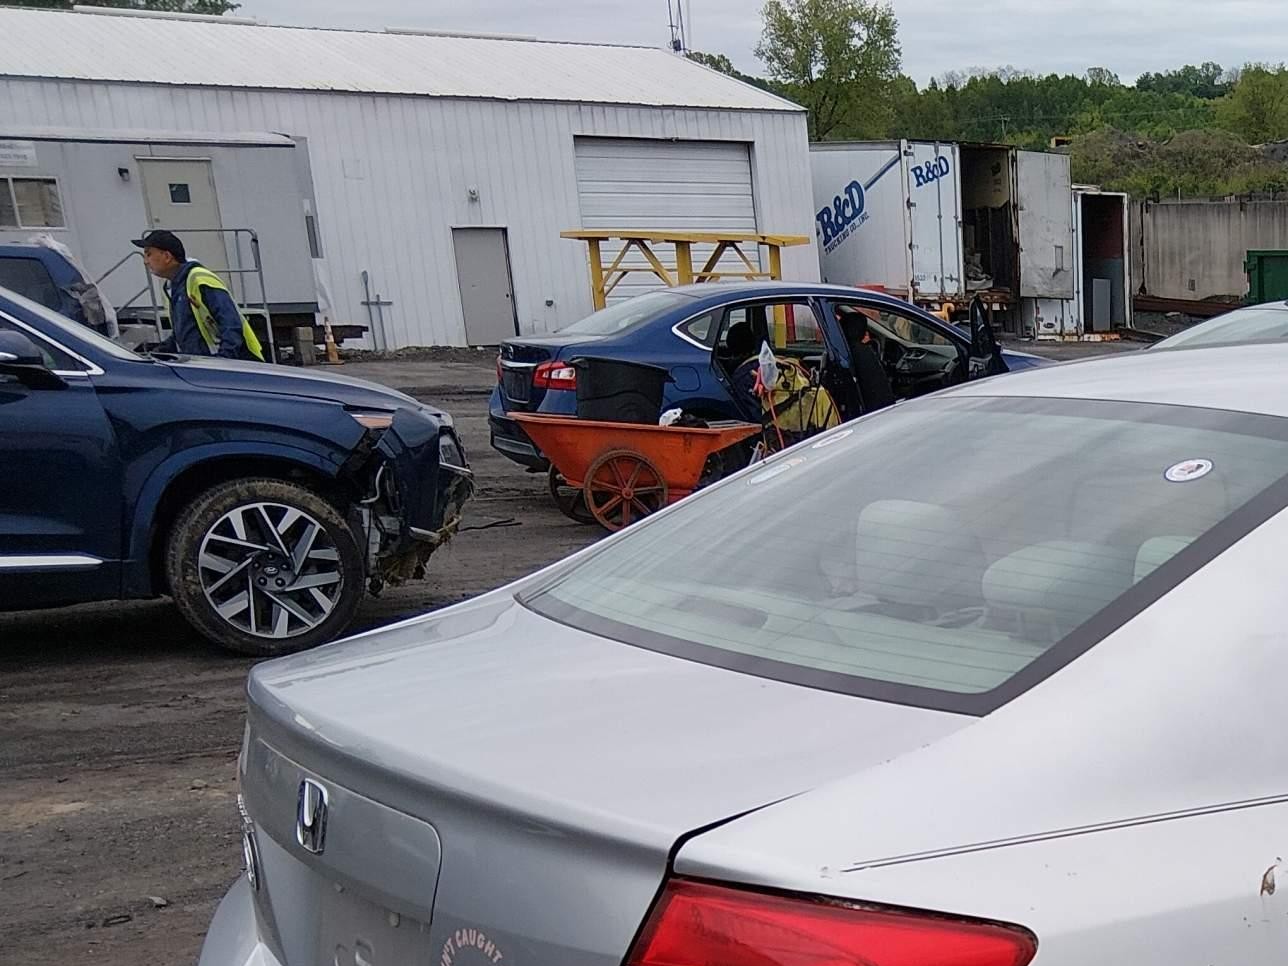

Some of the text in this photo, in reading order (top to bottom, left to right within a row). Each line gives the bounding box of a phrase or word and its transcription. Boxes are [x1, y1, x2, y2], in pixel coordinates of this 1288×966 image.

[911, 155, 950, 188] R&D
[816, 180, 865, 247] R&D
[824, 228, 850, 256] TRUCKING
[455, 928, 503, 964] CAUGHT
